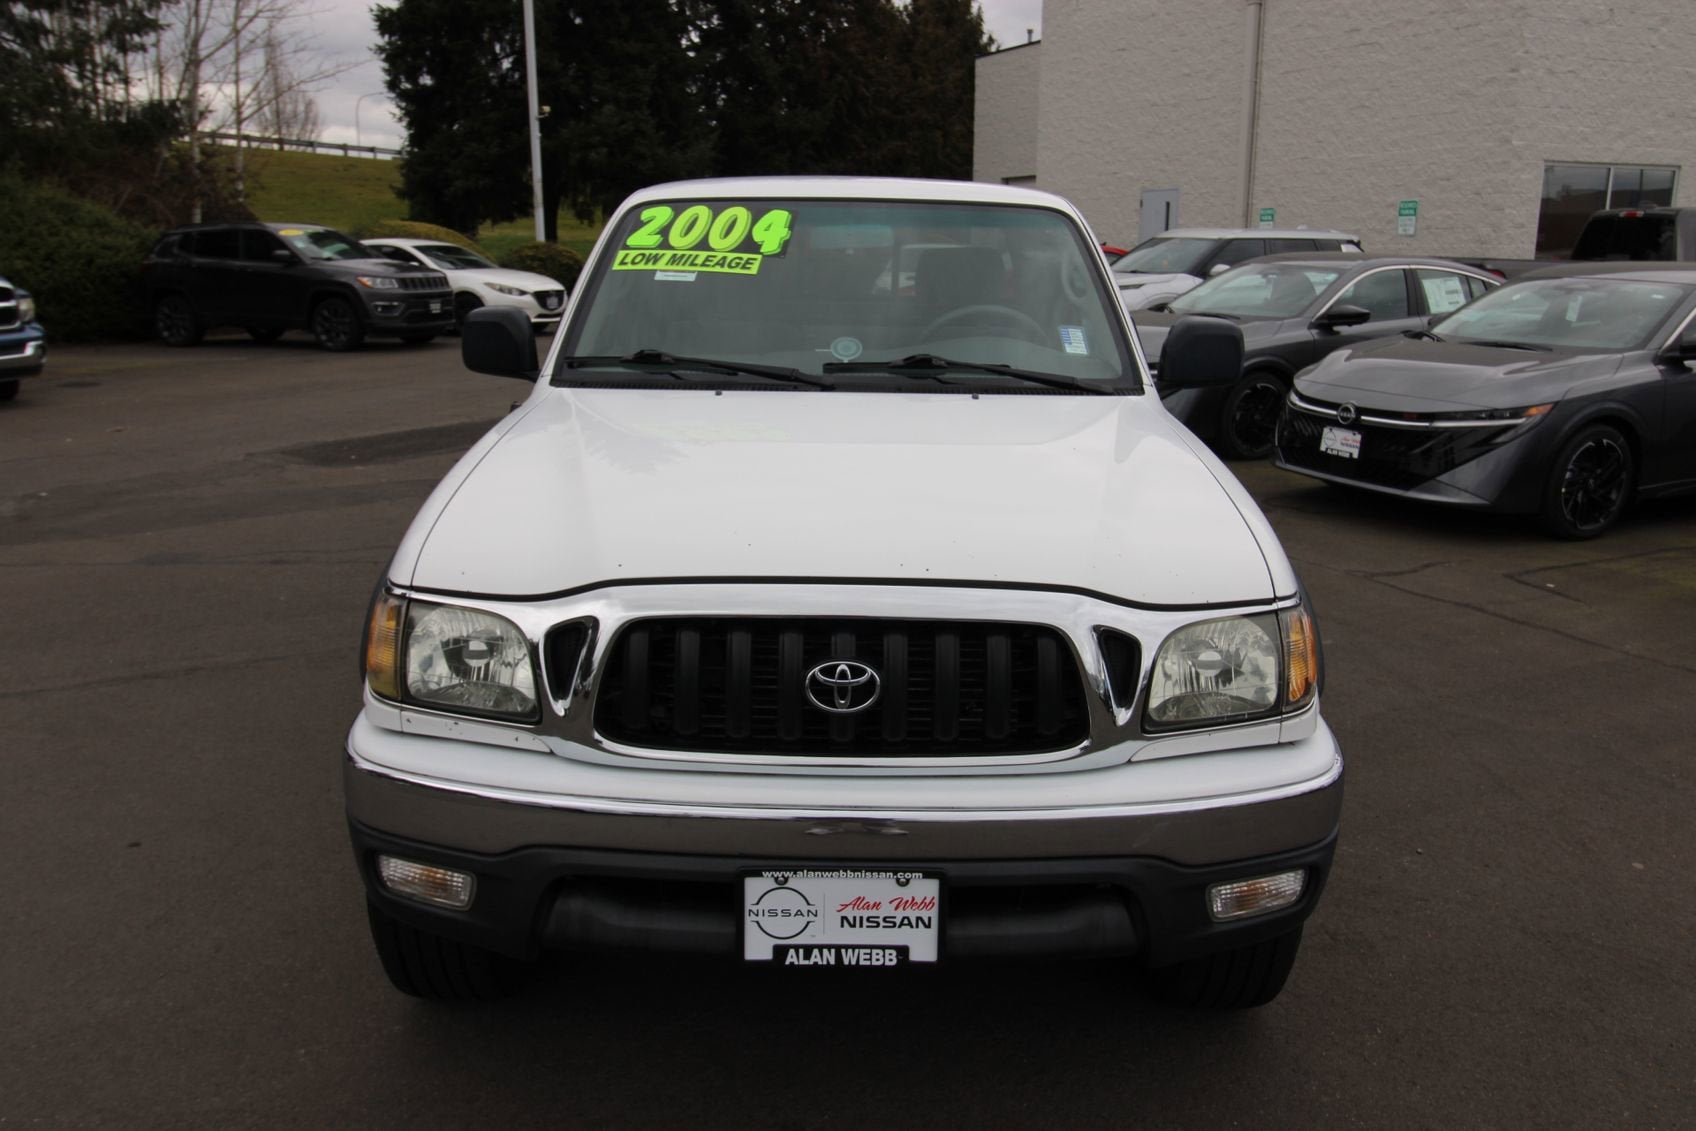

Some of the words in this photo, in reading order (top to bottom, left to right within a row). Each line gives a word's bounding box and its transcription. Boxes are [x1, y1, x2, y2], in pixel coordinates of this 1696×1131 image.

[626, 205, 792, 255] 2004
[617, 253, 664, 266] LOW
[665, 253, 758, 271] MILEAGE
[762, 870, 923, 879] www.alanwebbnissan.com
[748, 908, 818, 918] NISSAN
[836, 896, 882, 913] Alan
[889, 896, 936, 912] Webb
[840, 916, 932, 929] NISSAN
[785, 948, 835, 965] ALAN
[841, 949, 897, 966] WEBB
